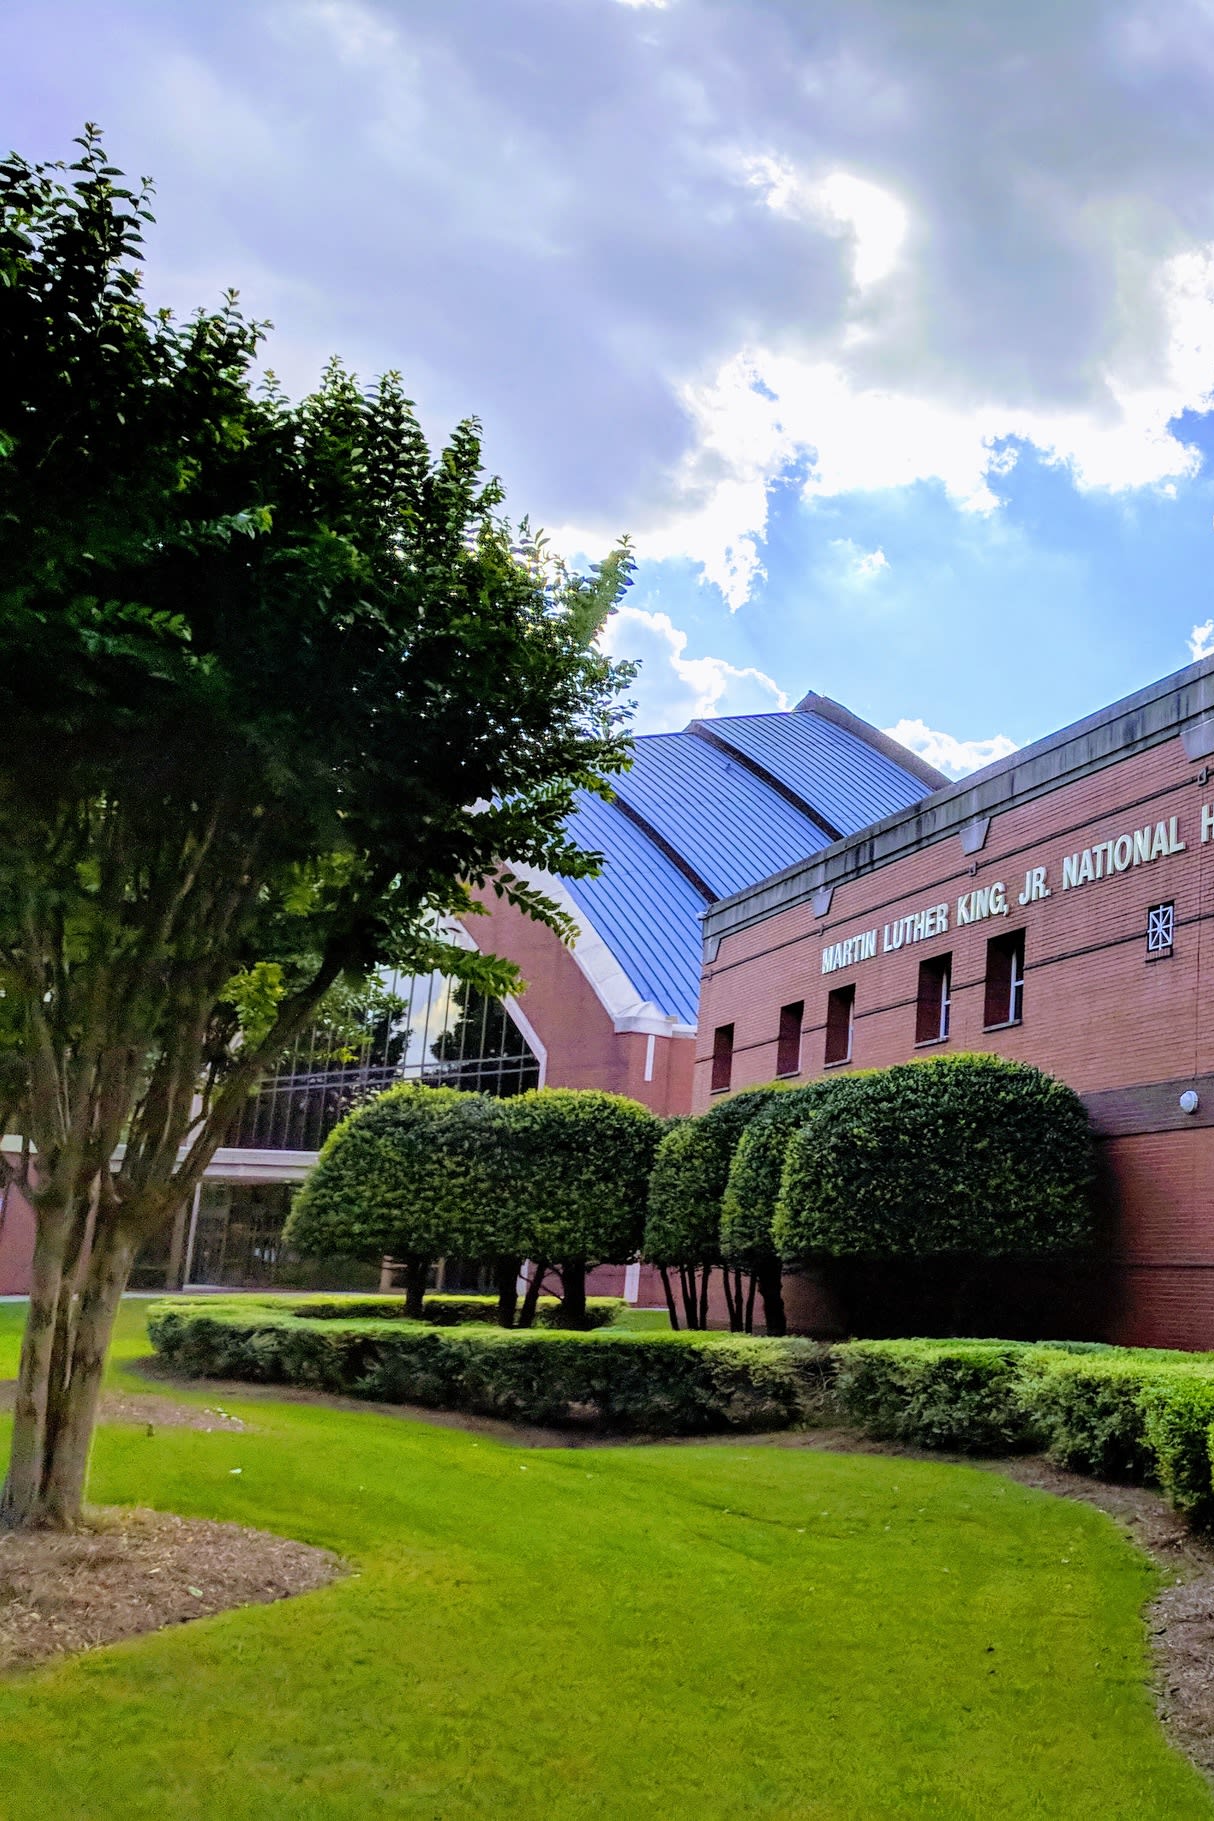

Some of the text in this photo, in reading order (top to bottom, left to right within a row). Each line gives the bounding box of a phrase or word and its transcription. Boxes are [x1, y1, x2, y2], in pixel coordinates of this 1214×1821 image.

[821, 929, 878, 974] MARTIN
[883, 900, 949, 954] LUTHER
[956, 881, 1010, 926] KING,
[1018, 866, 1051, 906] JR.
[1062, 816, 1186, 892] NATIONAL
